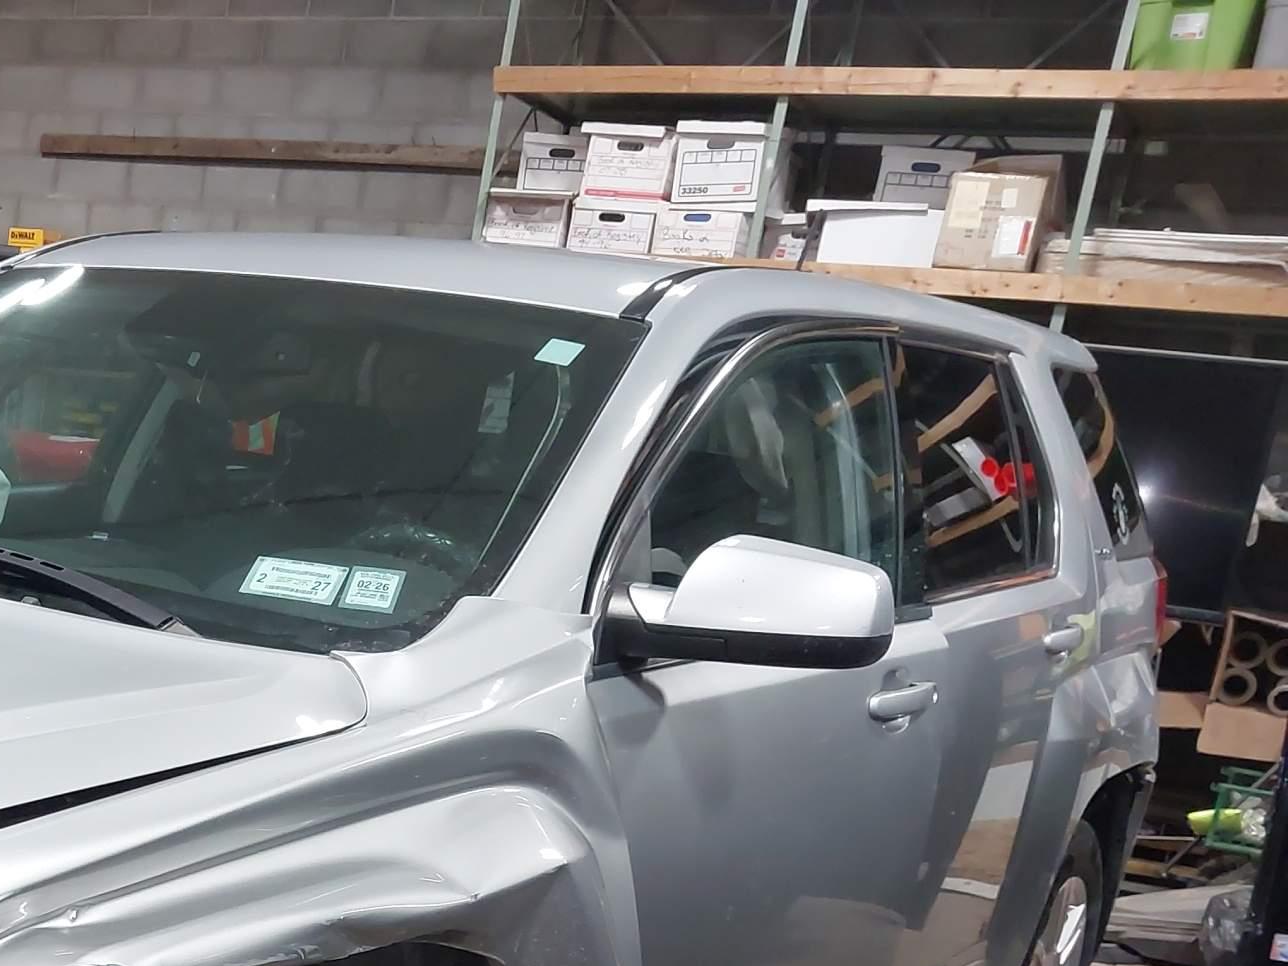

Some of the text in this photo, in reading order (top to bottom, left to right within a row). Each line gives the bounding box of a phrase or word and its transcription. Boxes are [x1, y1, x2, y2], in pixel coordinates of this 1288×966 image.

[681, 186, 709, 195] 33250
[256, 572, 268, 583] 2
[311, 580, 332, 592] 27
